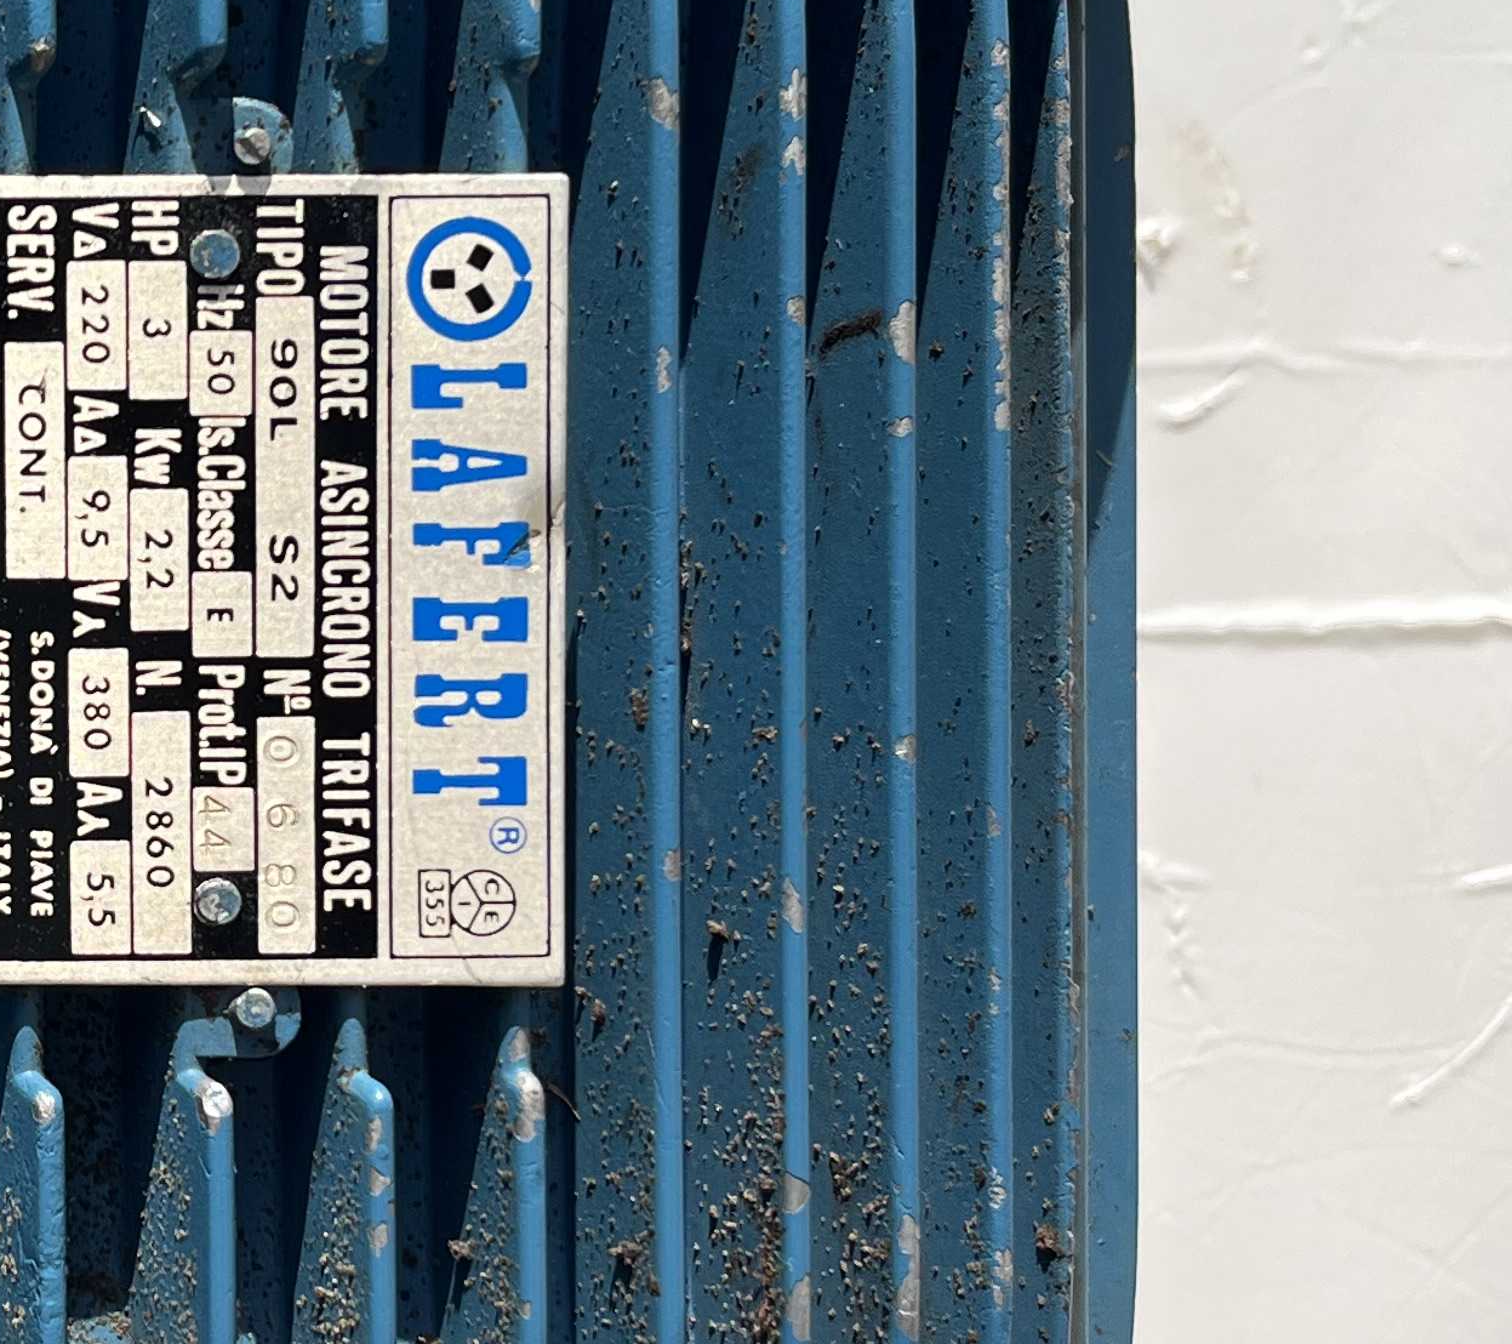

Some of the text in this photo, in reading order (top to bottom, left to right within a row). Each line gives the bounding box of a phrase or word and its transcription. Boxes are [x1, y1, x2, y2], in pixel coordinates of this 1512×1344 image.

[256, 199, 304, 295] TIPO
[82, 285, 110, 364] 220
[196, 284, 245, 330] Hz
[6, 204, 57, 514] SERV. CONT.
[208, 349, 234, 395] 50
[270, 339, 298, 441] 90L
[75, 489, 110, 548] 9,5
[131, 199, 183, 888] HP 3 Kw 2,2 N. 2860
[270, 534, 299, 602] S2
[320, 246, 371, 912] MOTORE ASINCRONO TRIFASE
[412, 362, 532, 807] LAFERT
[206, 608, 234, 622] E
[82, 675, 111, 750] 380
[29, 777, 53, 805] DI
[29, 830, 54, 918] PIAVE
[81, 873, 115, 927] 5,5
[425, 880, 445, 927] 355
